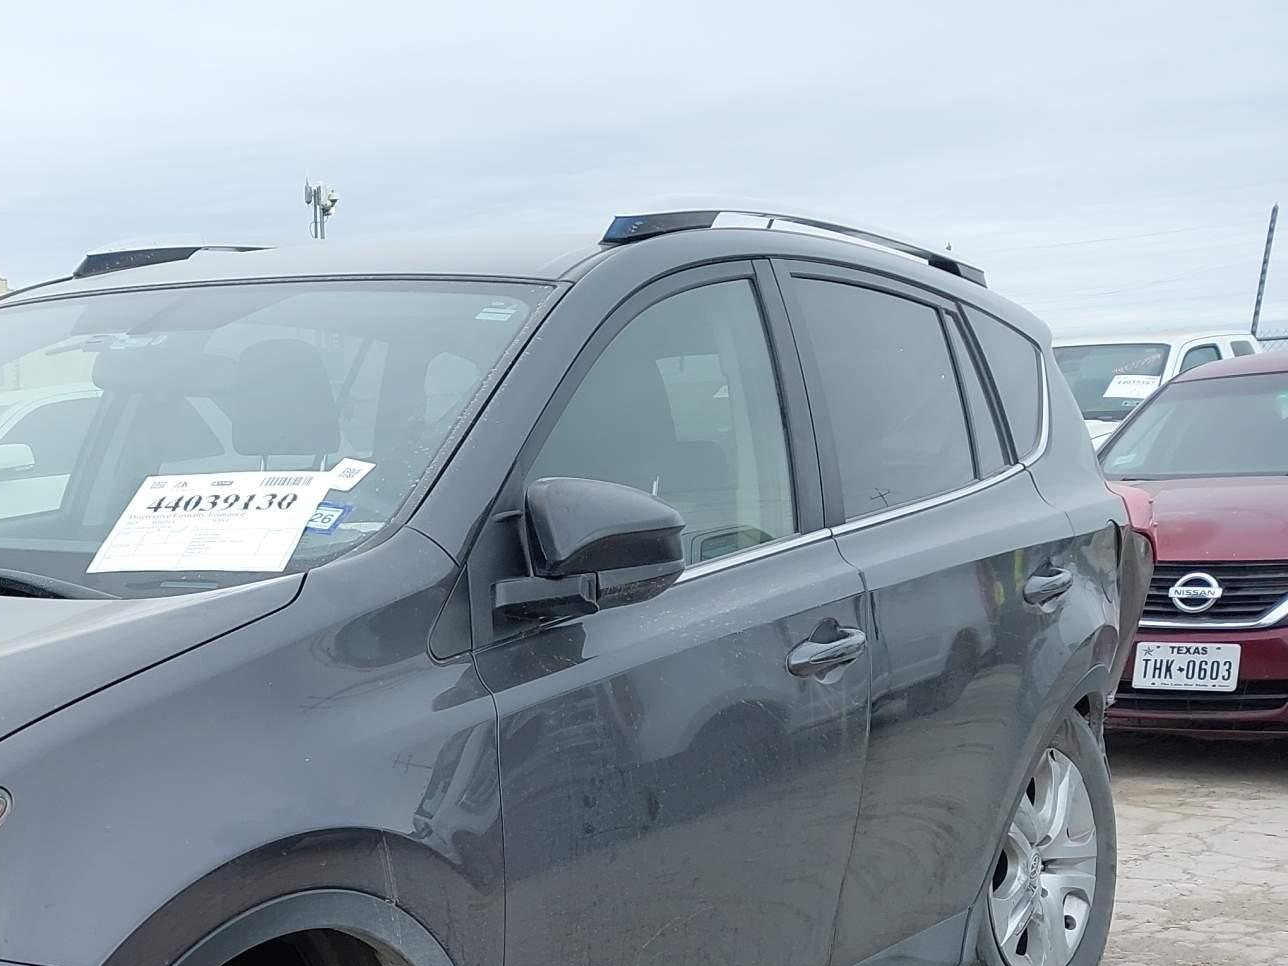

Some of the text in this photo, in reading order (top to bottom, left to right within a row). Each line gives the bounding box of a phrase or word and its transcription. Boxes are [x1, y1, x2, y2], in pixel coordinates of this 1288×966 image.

[146, 493, 298, 513] 44039130
[308, 512, 334, 524] 26
[1169, 645, 1208, 655] TEXAS
